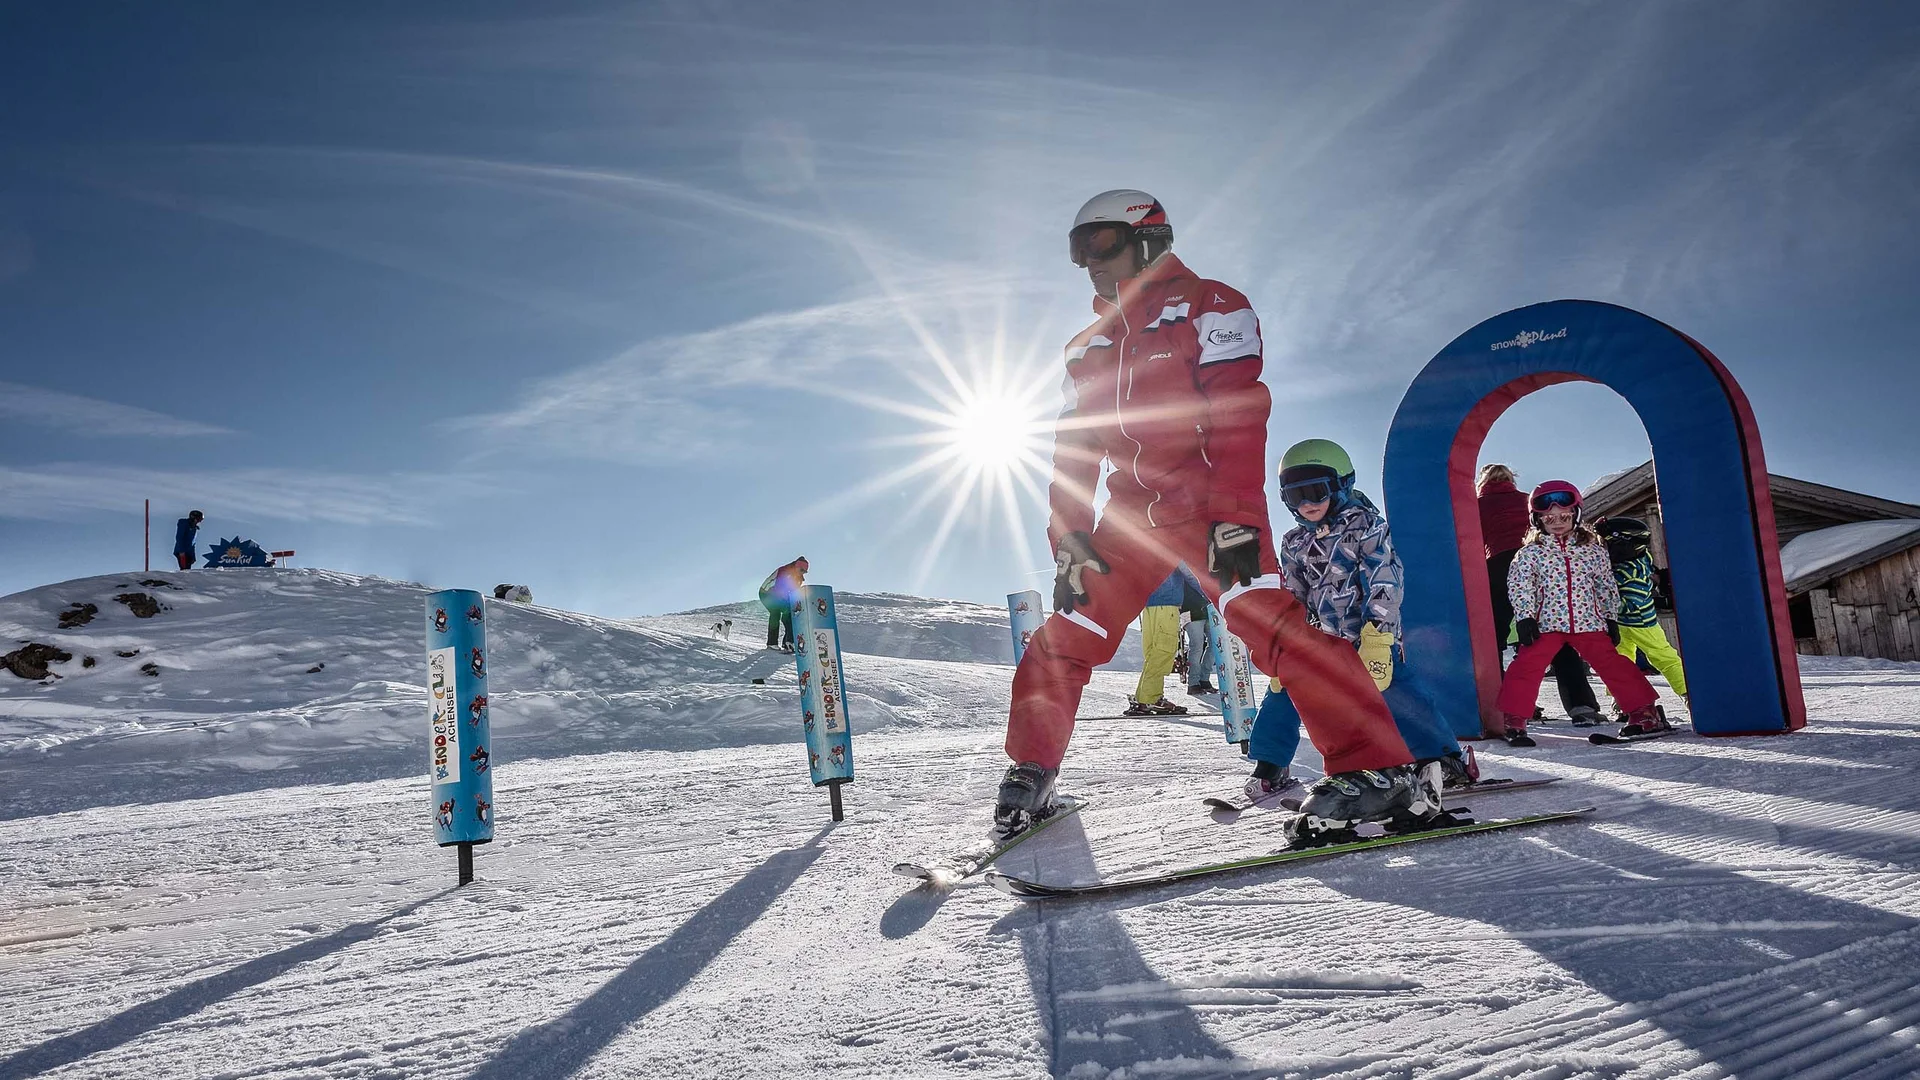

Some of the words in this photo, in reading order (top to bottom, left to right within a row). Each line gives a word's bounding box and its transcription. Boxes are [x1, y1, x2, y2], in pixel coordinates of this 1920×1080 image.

[1126, 204, 1158, 212] ATOM
[830, 658, 841, 703] ACHENSEE
[1242, 656, 1250, 686] ACHENSEE
[447, 687, 456, 742] ACHENSEE
